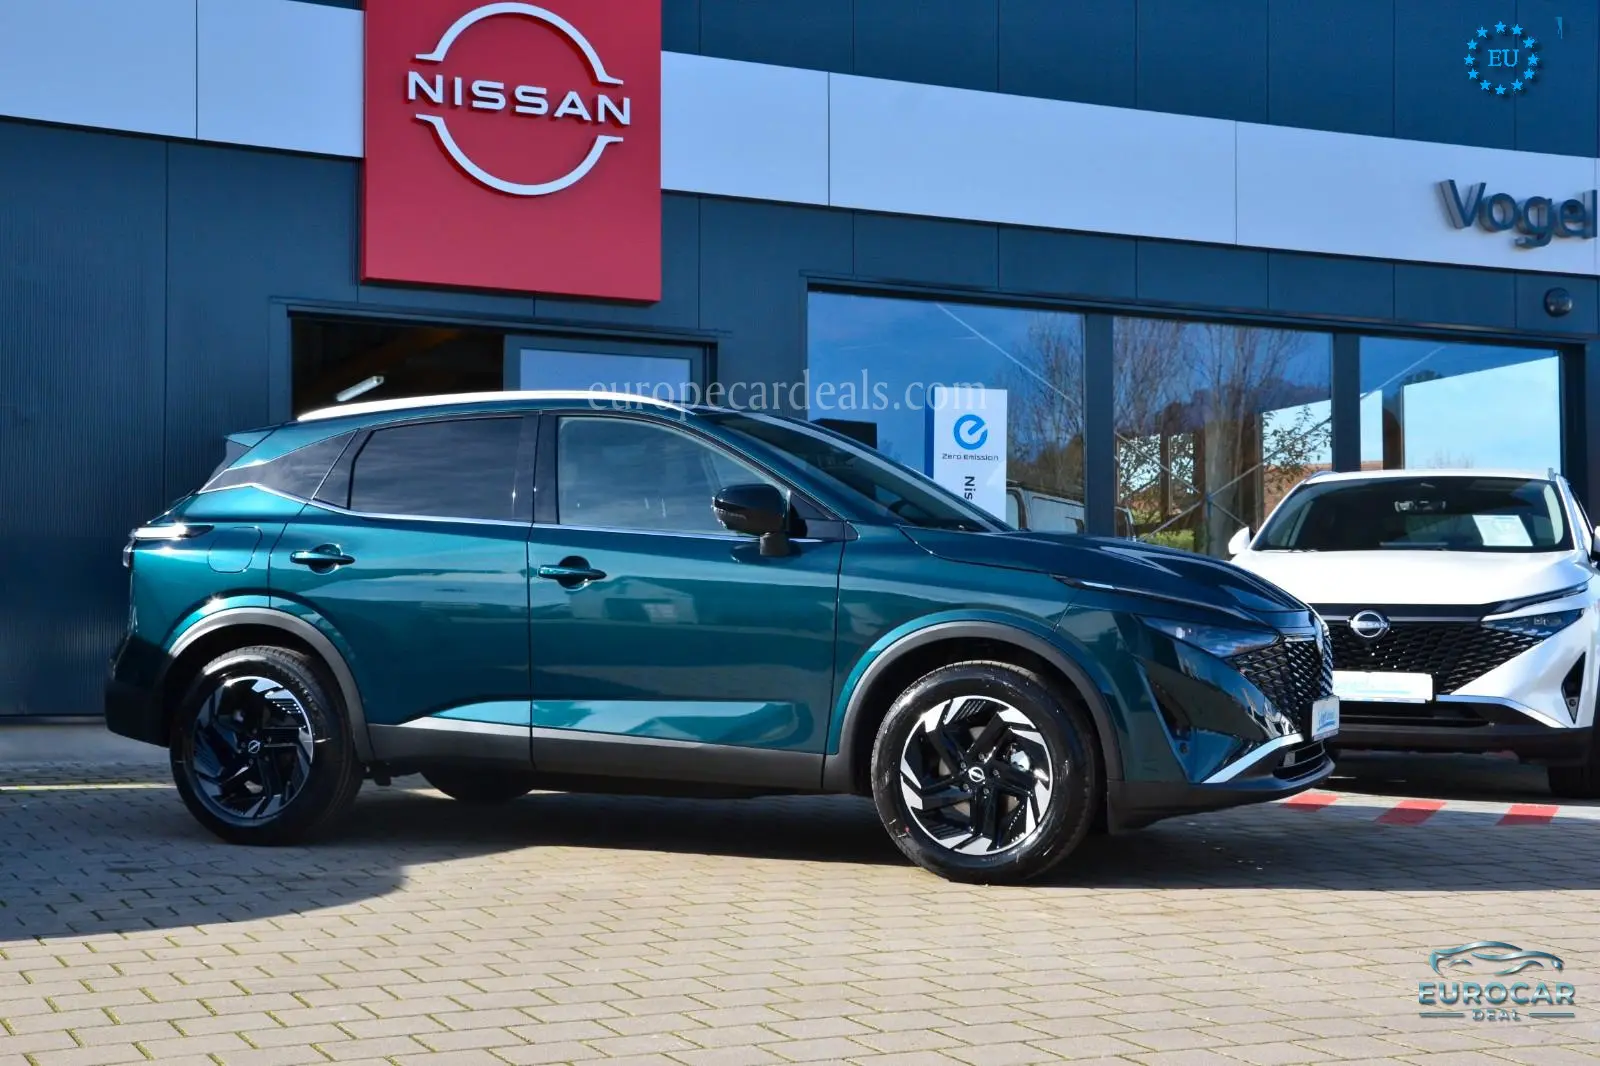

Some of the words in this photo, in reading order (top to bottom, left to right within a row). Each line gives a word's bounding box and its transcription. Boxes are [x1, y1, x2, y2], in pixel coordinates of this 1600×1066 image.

[407, 70, 631, 126] NISSAN
[1437, 179, 1598, 248] Vogel
[942, 452, 962, 460] Zero
[963, 453, 999, 461] Emission
